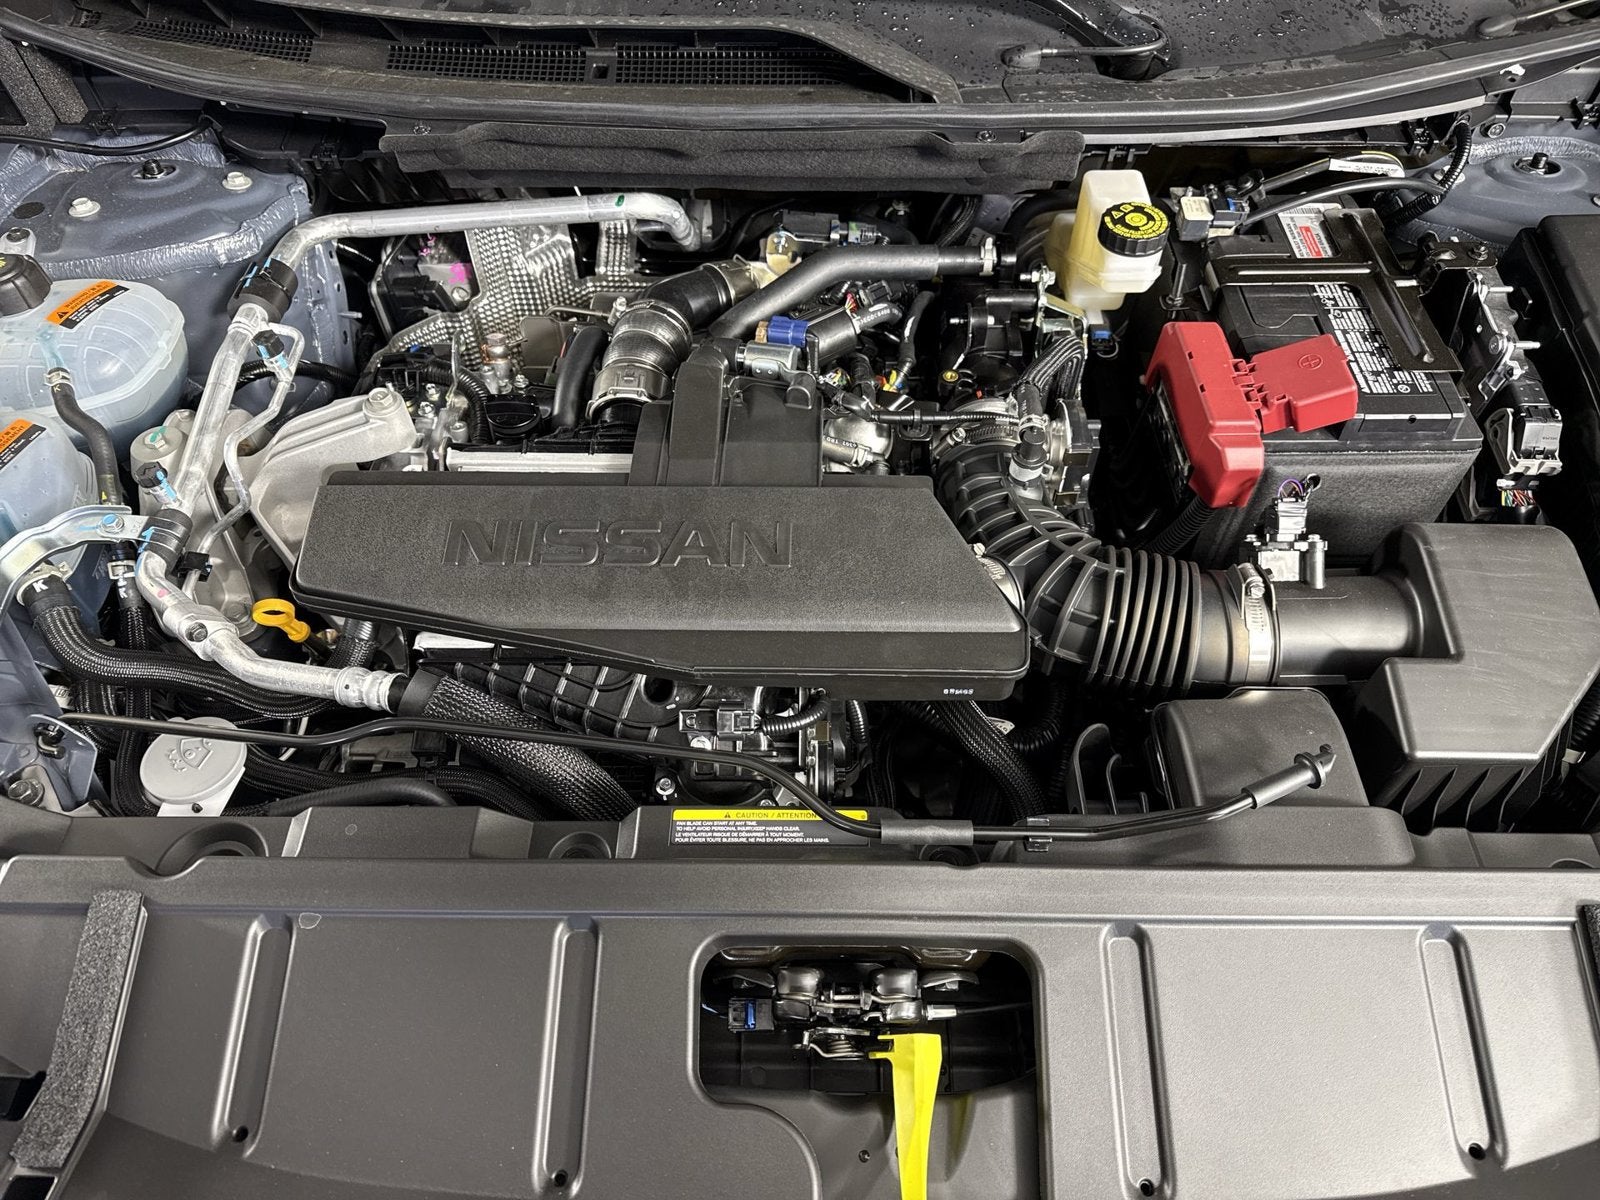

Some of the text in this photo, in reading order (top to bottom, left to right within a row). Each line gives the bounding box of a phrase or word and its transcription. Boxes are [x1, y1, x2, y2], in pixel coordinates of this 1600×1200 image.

[53, 384, 61, 393] K
[442, 520, 794, 567] NISSAN
[32, 579, 49, 593] K
